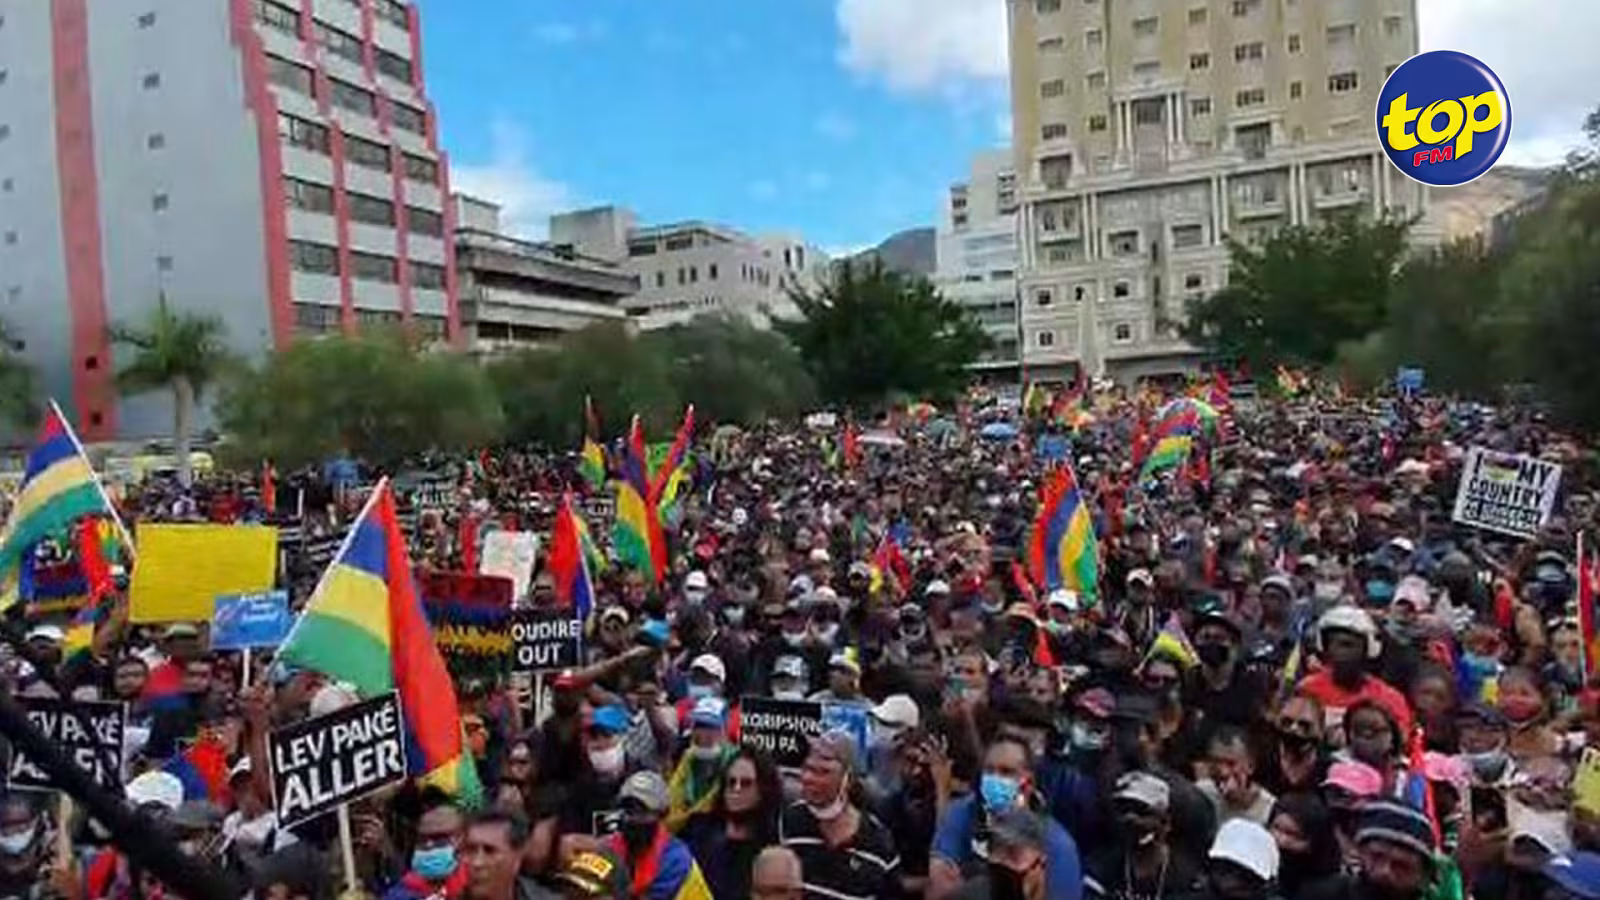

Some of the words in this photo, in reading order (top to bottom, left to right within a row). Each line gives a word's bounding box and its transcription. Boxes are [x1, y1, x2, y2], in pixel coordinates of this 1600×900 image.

[1518, 460, 1555, 486] MY
[519, 643, 562, 664] OUT
[276, 729, 326, 773] LEV
[331, 702, 397, 754] PAKÉ
[280, 739, 402, 819] ALLER
